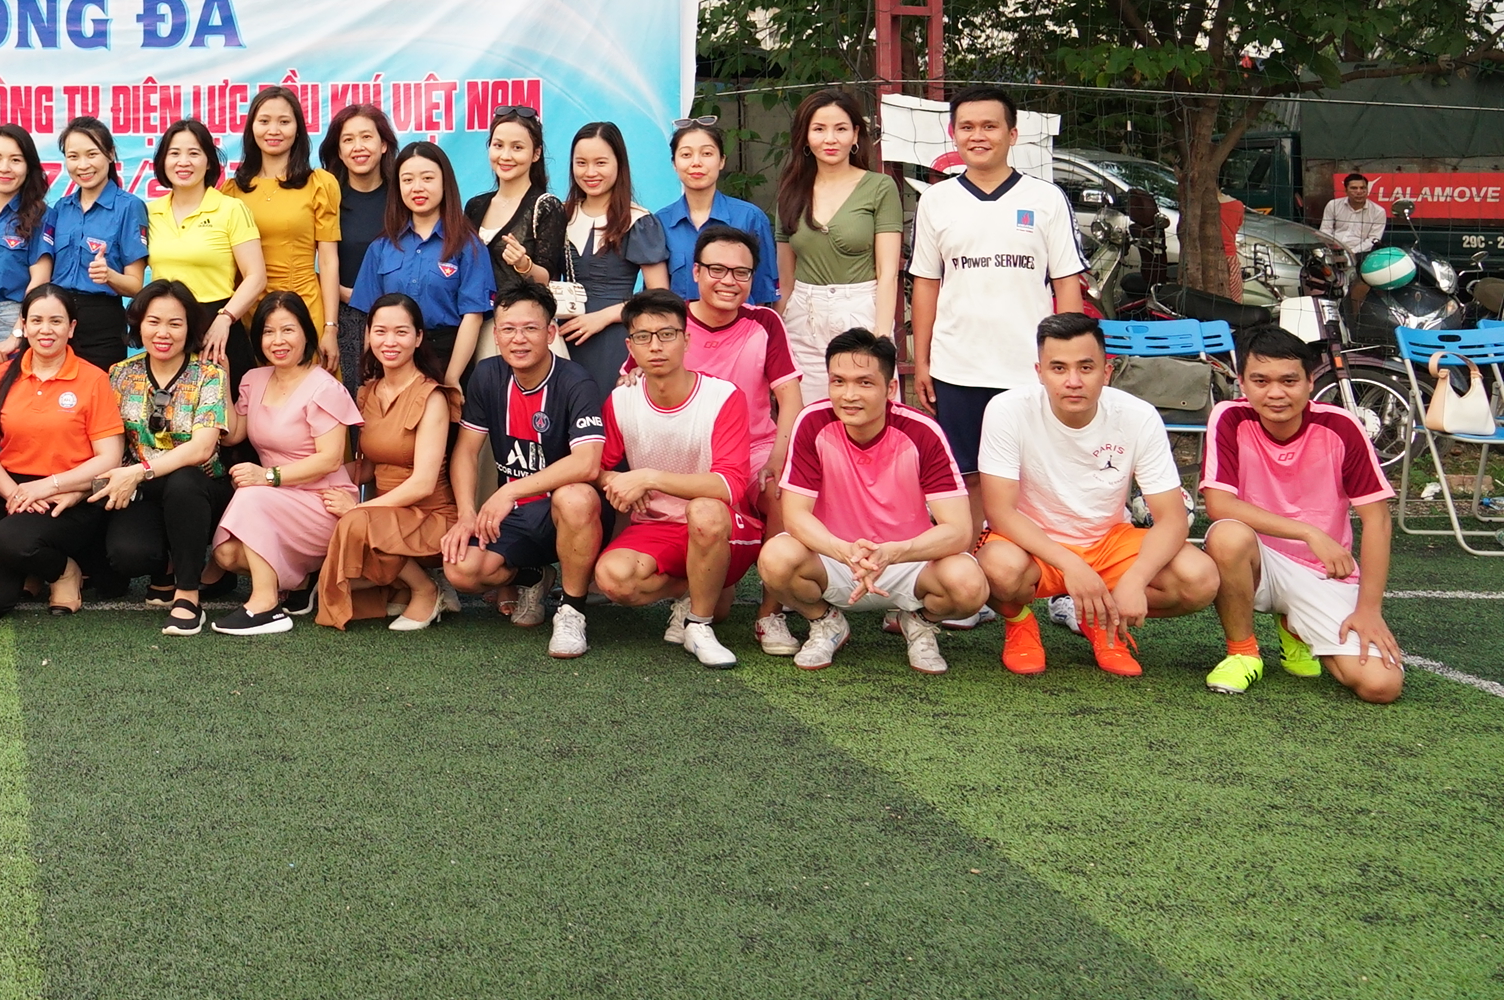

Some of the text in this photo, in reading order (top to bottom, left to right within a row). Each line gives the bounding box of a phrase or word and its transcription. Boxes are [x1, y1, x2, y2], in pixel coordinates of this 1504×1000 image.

[110, 75, 182, 147] ĐIỆN
[392, 72, 457, 144] VIỆT
[1377, 186, 1501, 203] LALAMOVE
[1462, 235, 1486, 248] 29C
[576, 416, 603, 429] QNB
[1092, 443, 1125, 458] PARIS
